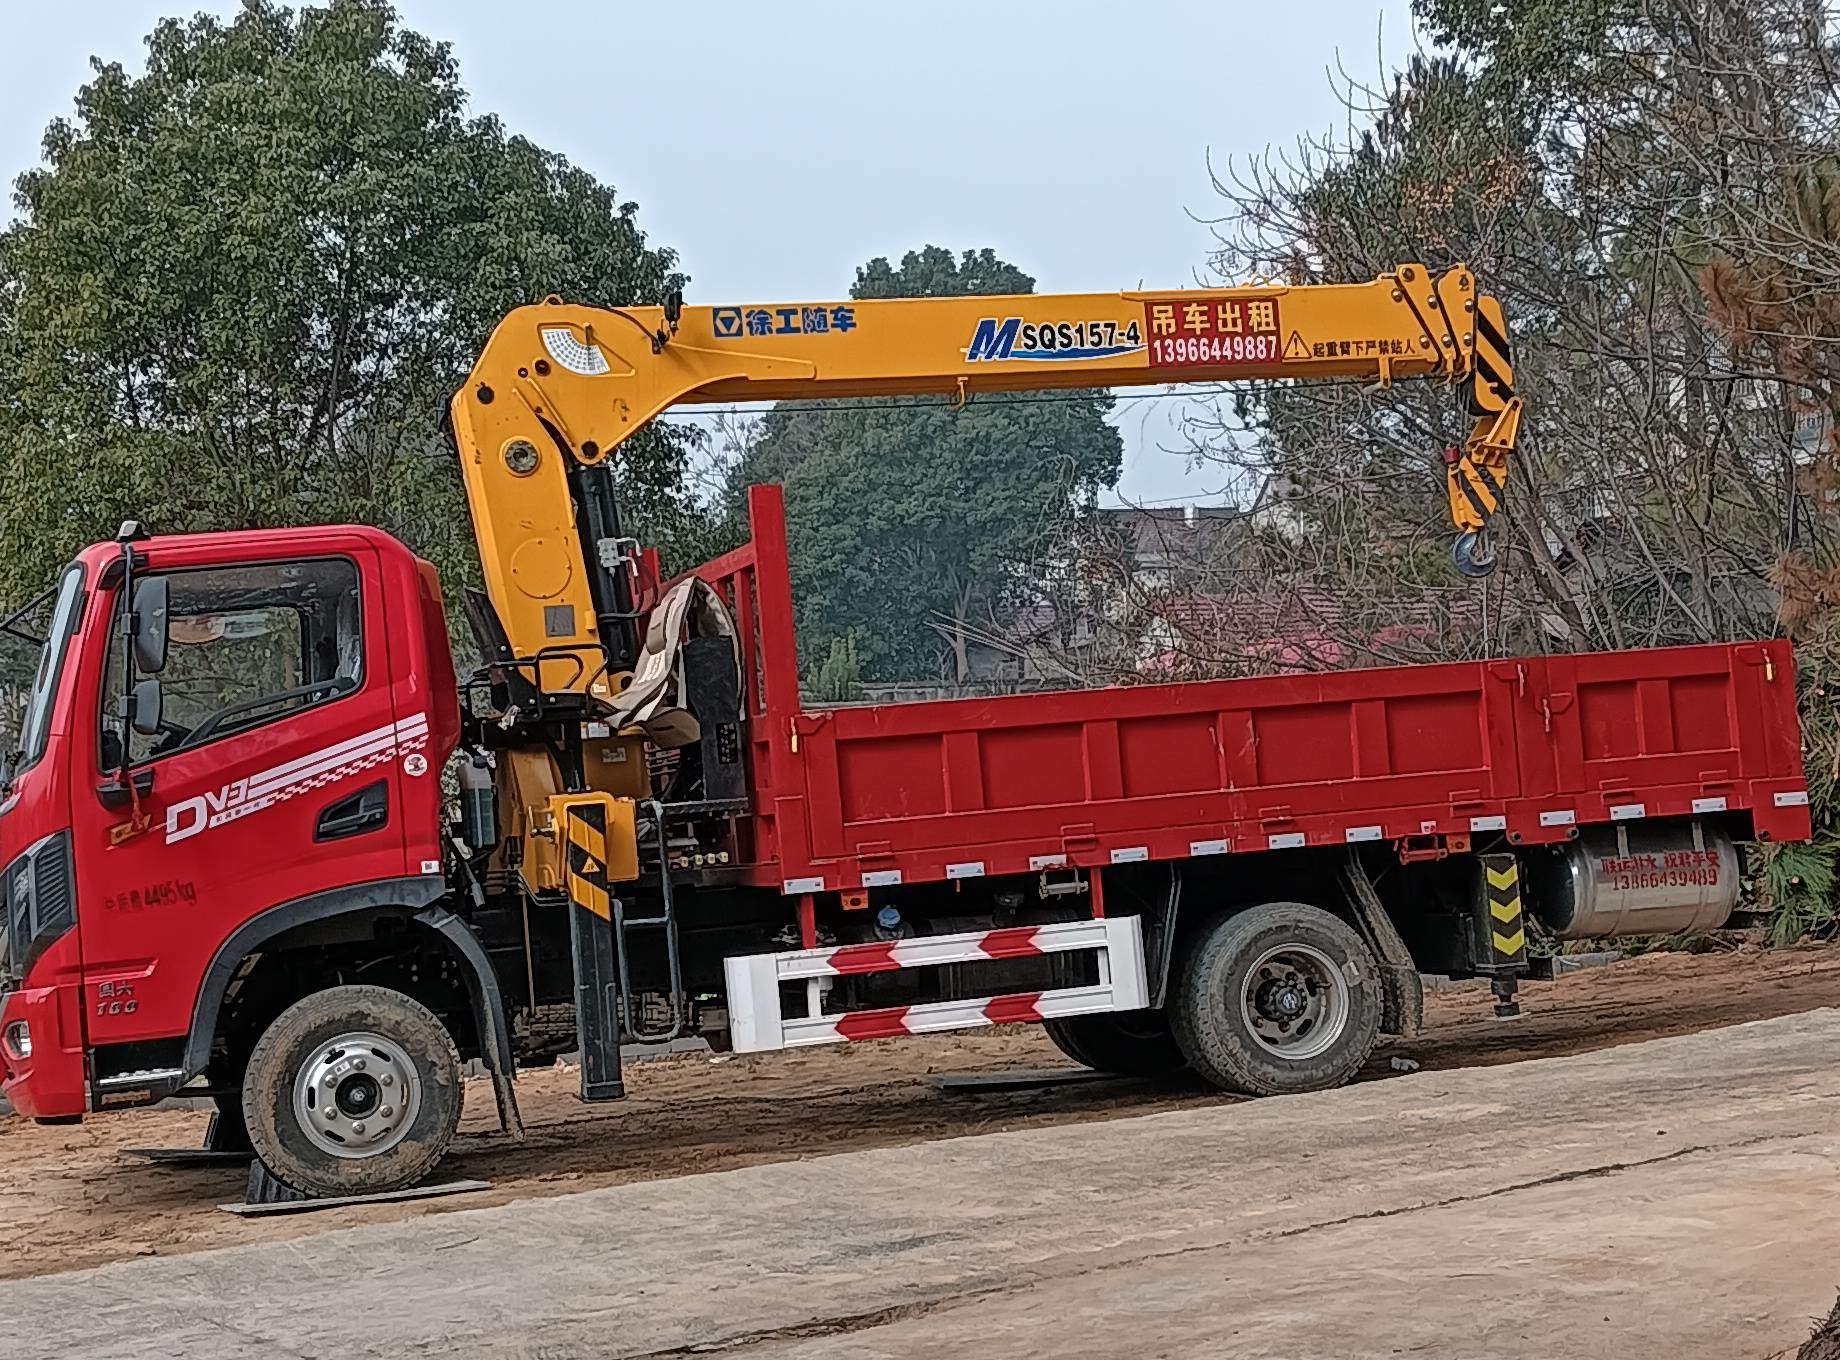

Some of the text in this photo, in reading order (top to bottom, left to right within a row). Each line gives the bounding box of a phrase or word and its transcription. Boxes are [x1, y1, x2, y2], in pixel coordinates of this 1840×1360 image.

[745, 306, 857, 337] 徐工随车
[1151, 301, 1278, 336] 吊车出租
[1021, 321, 1142, 351] SQS157-4
[1152, 335, 1278, 363] 13966449887
[1312, 338, 1416, 358] 起重臂下严禁站人
